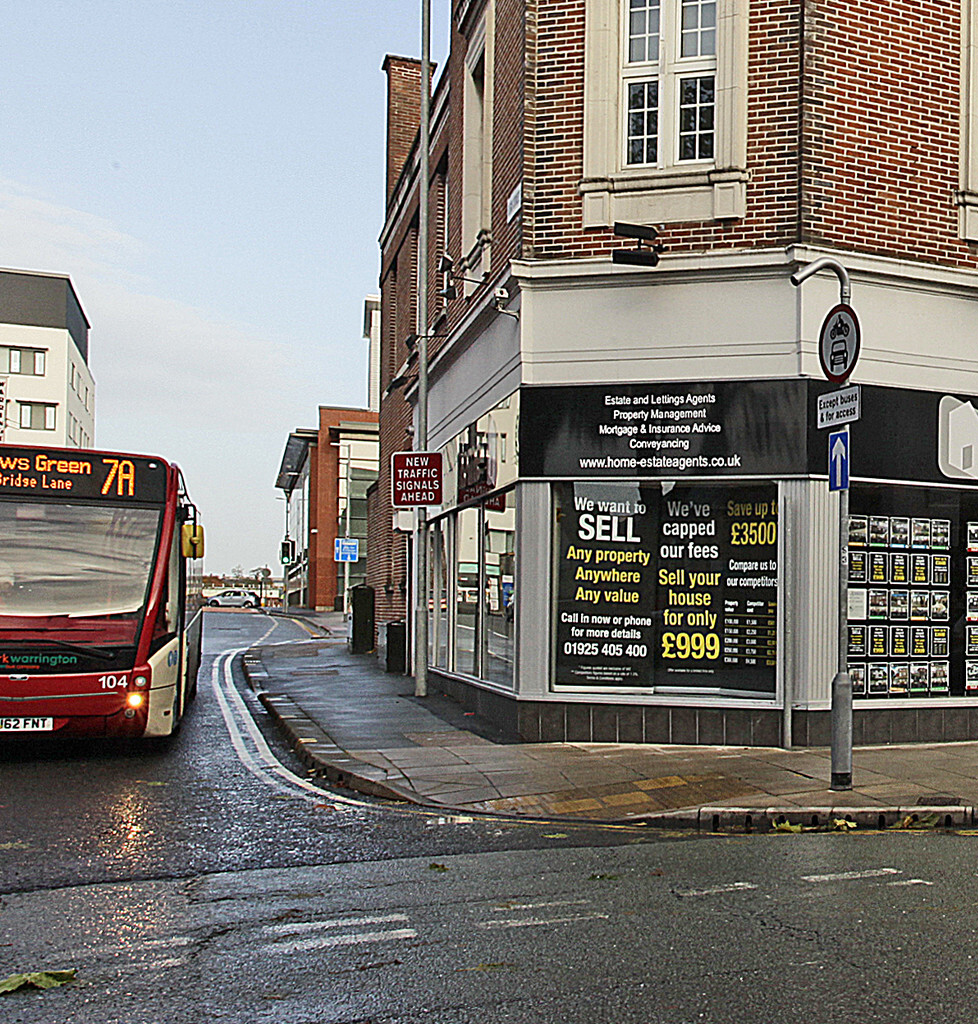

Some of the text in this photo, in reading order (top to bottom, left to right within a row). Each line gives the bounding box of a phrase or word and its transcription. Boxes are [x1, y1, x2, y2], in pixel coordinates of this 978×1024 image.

[605, 393, 715, 406] Estate and Lettings Agents
[819, 393, 857, 410] Except buses
[613, 408, 707, 421] Property Management
[820, 407, 856, 422] & for access
[599, 423, 721, 436] Mortgage & Insurance Advice
[630, 438, 690, 450] Conveyancing
[35, 454, 92, 475] Green
[406, 457, 429, 466] NEW
[580, 454, 741, 470] www.home-estateagents.co.uk
[101, 458, 135, 496] 7A
[398, 468, 438, 478] TRAFFIC
[42, 474, 73, 490] Lane
[396, 480, 440, 490] SIGNALS
[400, 492, 435, 502] AHEAD
[574, 496, 646, 514] We want to
[667, 501, 710, 516] We've
[728, 500, 752, 516] Save
[755, 502, 768, 519] up
[578, 514, 640, 542] SELL
[662, 520, 715, 540] capped
[566, 546, 650, 566] Any property
[660, 542, 719, 558] our fees
[729, 559, 776, 572] Compare us to
[575, 566, 640, 584] Anywhere
[658, 569, 721, 588] Sell your
[727, 576, 778, 589] our competitors
[575, 586, 640, 604] Any value
[668, 590, 712, 606] house
[561, 612, 652, 627] Call in now or phone
[664, 609, 718, 630] for only
[571, 626, 642, 639] for more details
[564, 642, 648, 657] 01925 405 400
[662, 632, 720, 660] £999
[10, 652, 77, 666] warrington
[98, 675, 128, 689] 104
[23, 718, 48, 728] FNT
